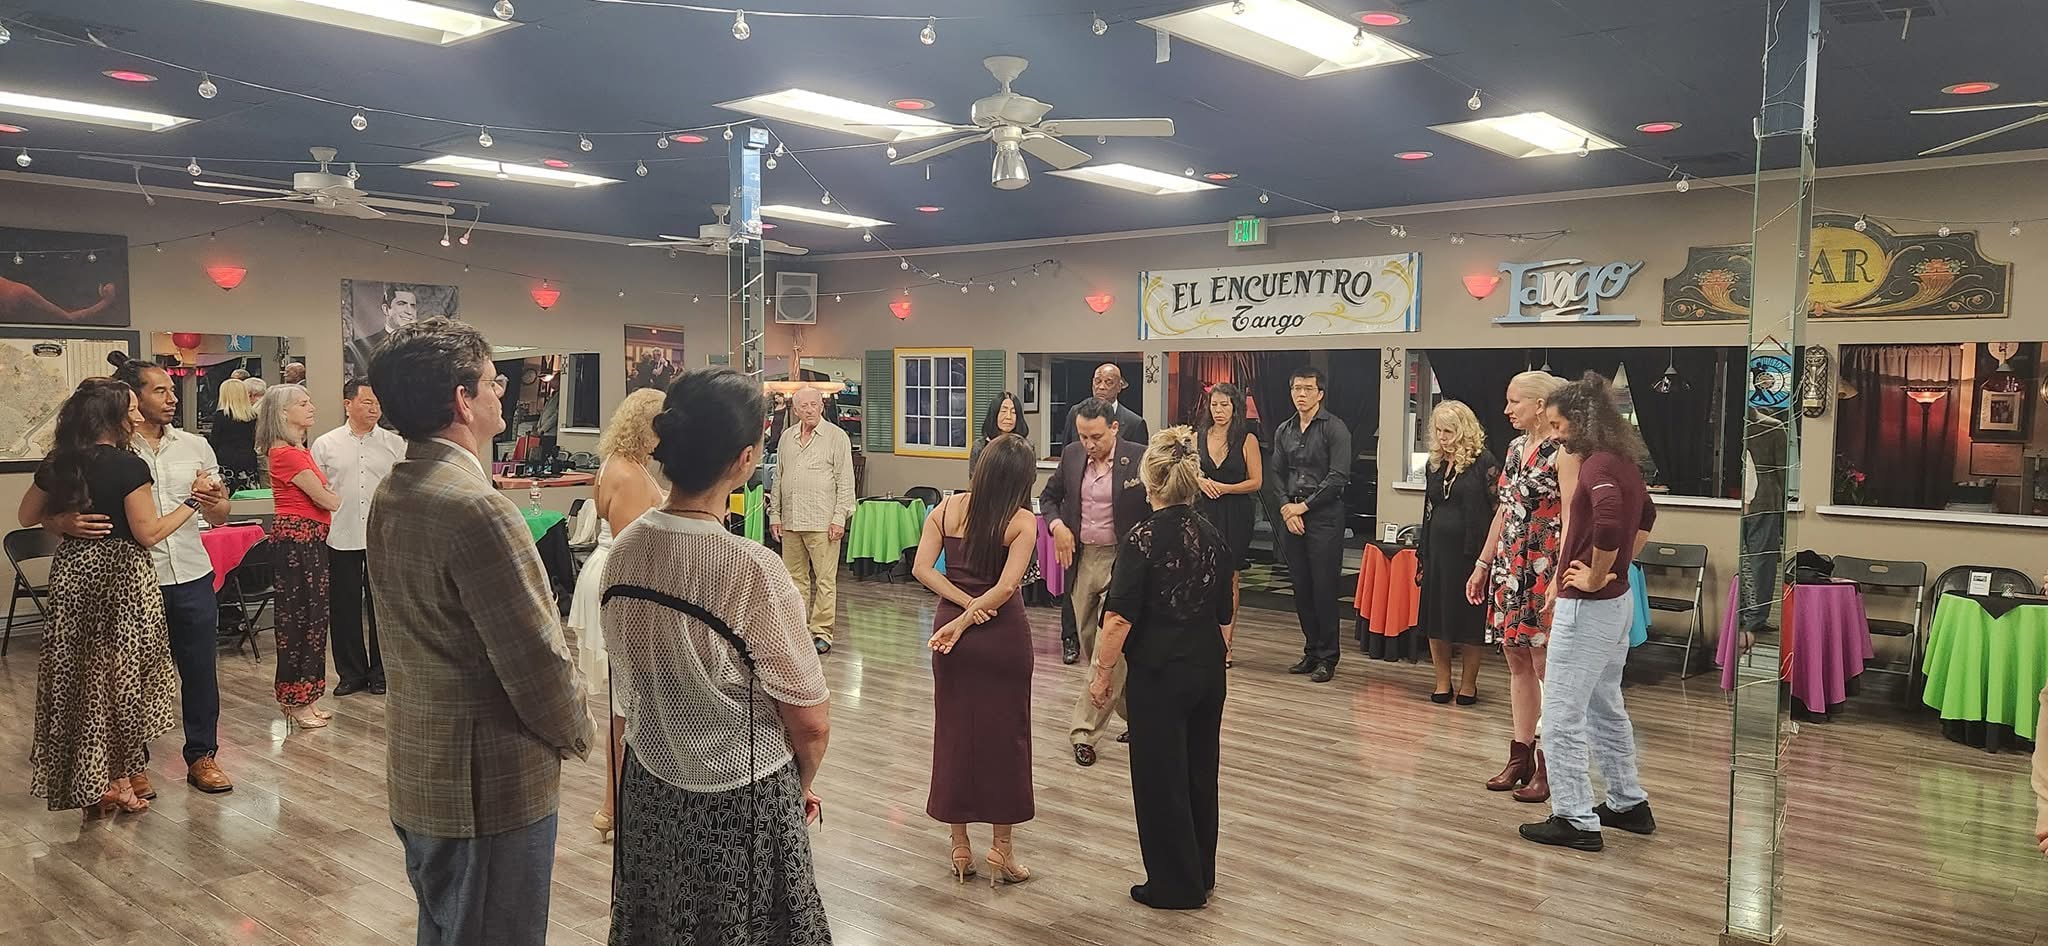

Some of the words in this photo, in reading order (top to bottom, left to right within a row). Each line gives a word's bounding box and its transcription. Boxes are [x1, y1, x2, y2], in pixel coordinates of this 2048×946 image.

[1234, 219, 1260, 242] EXIT
[1809, 248, 1874, 284] AR
[1172, 281, 1202, 314] EL
[1210, 269, 1373, 305] ENCUENTRO
[1497, 258, 1645, 323] Tango
[1231, 305, 1305, 335] Tango
